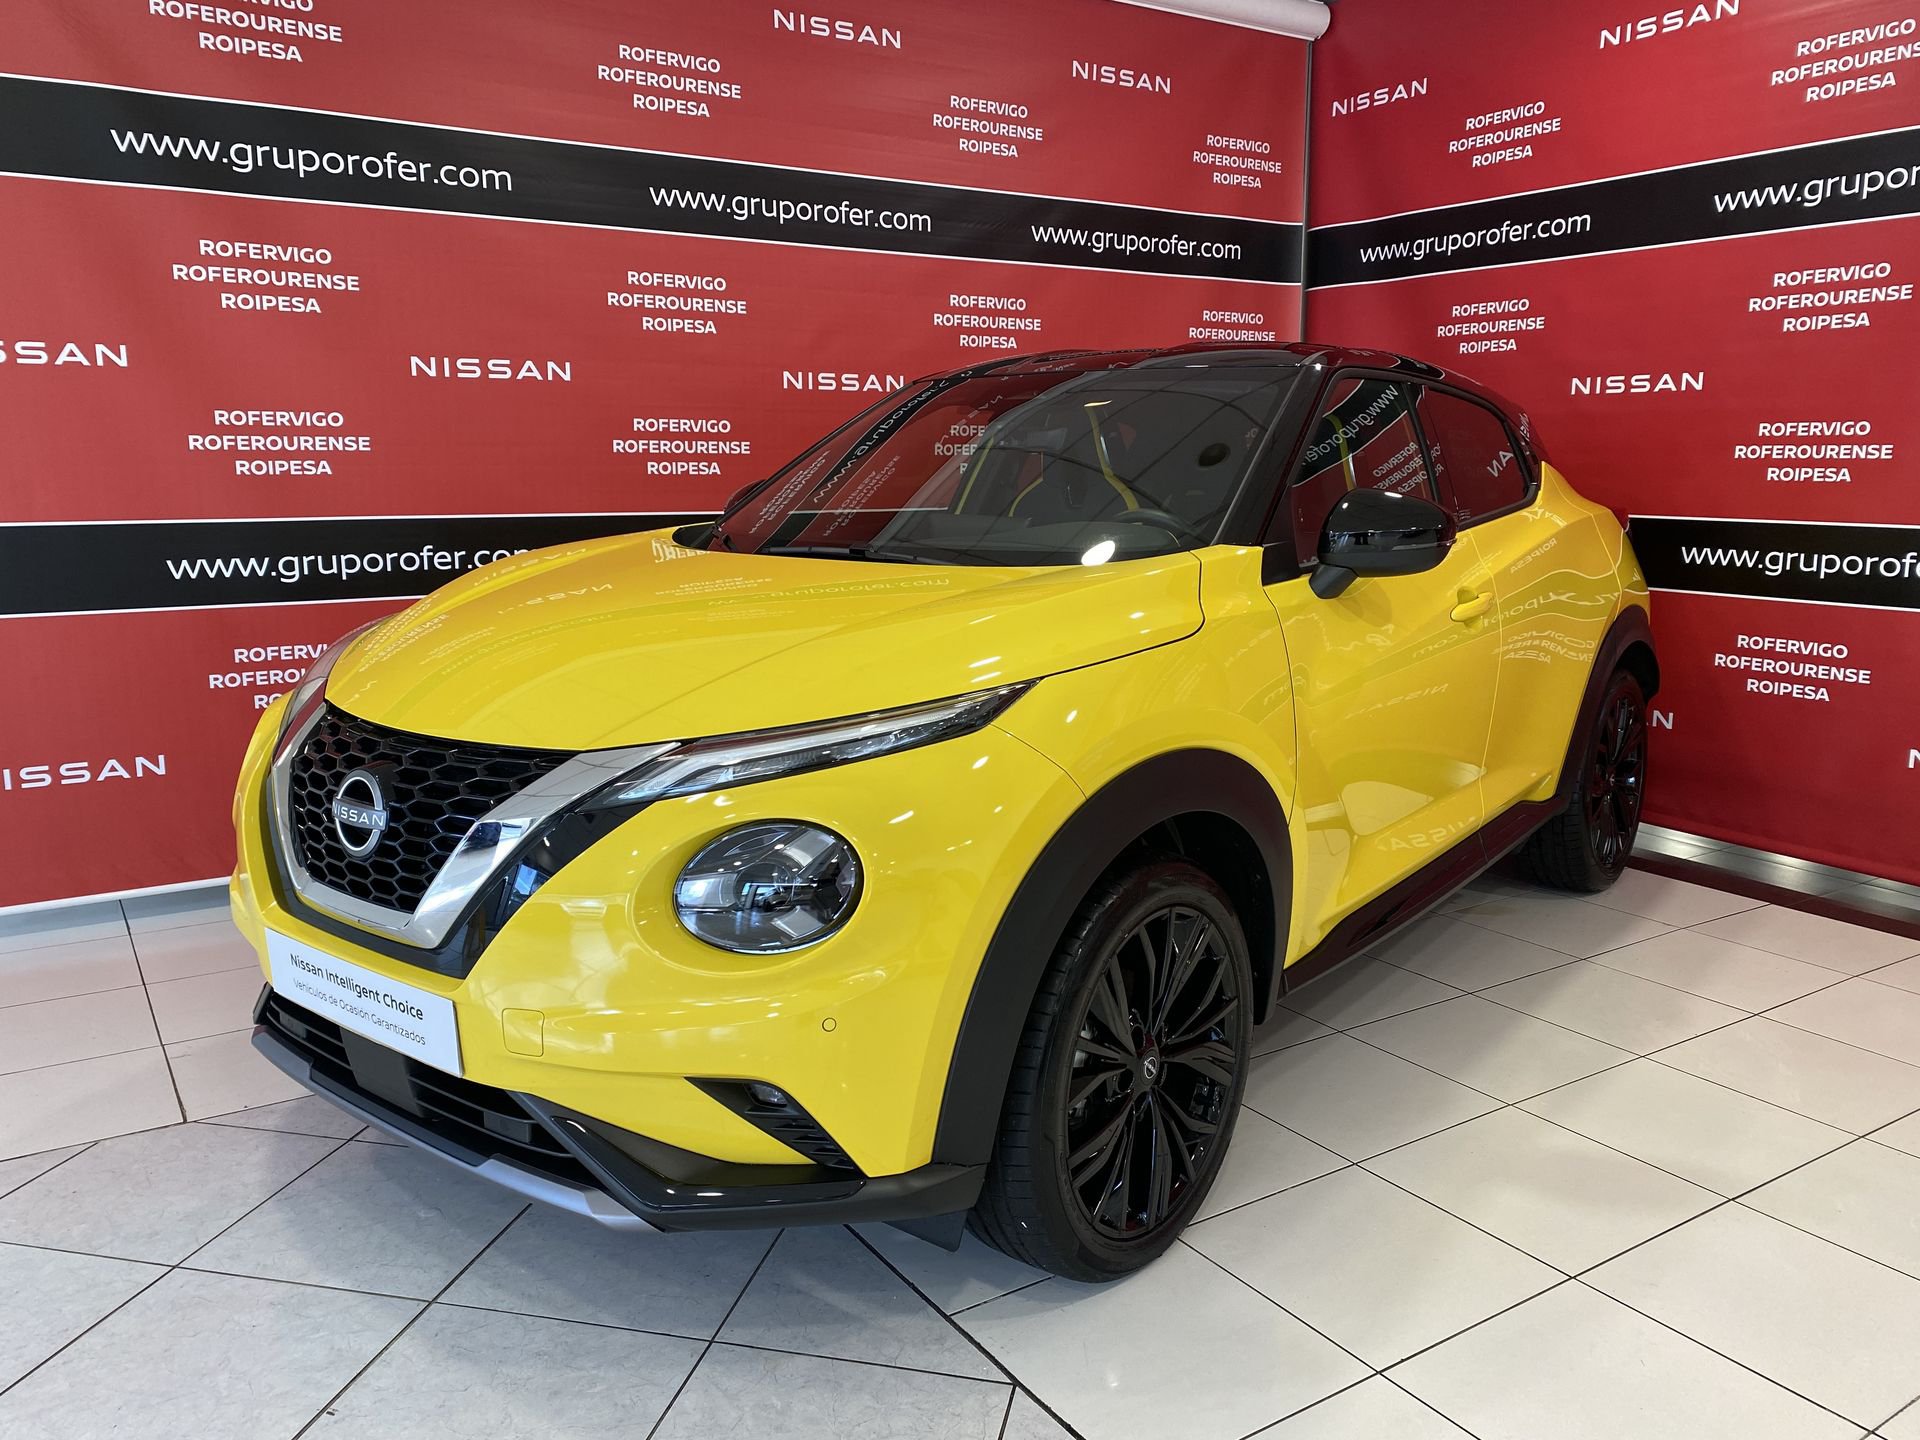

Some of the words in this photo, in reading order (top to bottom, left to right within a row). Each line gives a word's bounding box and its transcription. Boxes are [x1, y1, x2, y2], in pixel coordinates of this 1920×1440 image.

[149, 0, 342, 42] ROFEROURENSE
[774, 10, 900, 48] NISSAN
[1600, 0, 1739, 48] NISSAN
[199, 32, 302, 62] ROIPESA
[1797, 19, 1916, 56] ROFERVIGO
[620, 45, 720, 72] ROFERVIGO
[598, 65, 741, 98] ROFEROURENSE
[1073, 61, 1170, 93] NISSAN
[1807, 72, 1895, 102] ROIPESA
[634, 94, 709, 117] ROIPESA
[951, 96, 1027, 118] ROFERVIGO
[1333, 78, 1427, 116] NISSAN
[934, 114, 1042, 140] ROFEROURENSE
[1466, 102, 1544, 130] ROFERVIGO
[1207, 135, 1269, 153] ROFERVIGO
[1450, 118, 1561, 152] ROFEROURENSE
[960, 139, 1017, 157] ROIPESA
[1473, 145, 1532, 167] ROIPESA
[110, 130, 511, 190] www.gruporofer.com
[1194, 151, 1281, 173] ROFEROURENSE
[1214, 173, 1261, 188] ROIPESA
[650, 187, 930, 232] www.gruporofer.com
[1032, 226, 1240, 259] www.gruporofer.com
[1361, 215, 1590, 262] www.gruporofer.com
[200, 240, 331, 264] ROFERVIGO
[173, 264, 359, 290] ROFEROURENSE
[628, 271, 726, 290] ROFERVIGO
[1774, 263, 1890, 287] ROFERVIGO
[221, 293, 321, 313] ROIPESA
[608, 292, 746, 313] ROFEROURENSE
[950, 295, 1026, 310] ROFERVIGO
[1453, 299, 1529, 317] ROFERVIGO
[1749, 285, 1913, 311] ROFEROURENSE
[643, 317, 716, 333] ROIPESA
[934, 314, 1041, 330] ROFEROURENSE
[1203, 311, 1263, 324] ROFERVIGO
[1438, 317, 1544, 336] ROFEROURENSE
[1783, 313, 1869, 331] ROIPESA
[960, 335, 1017, 348] ROIPESA
[1190, 328, 1275, 341] ROFEROURENSE
[0, 341, 127, 366] SAN
[1460, 339, 1516, 353] ROIPESA
[411, 357, 570, 381] NISSAN
[783, 371, 903, 392] NISSAN
[1571, 372, 1703, 394] NISSAN
[215, 411, 343, 426] ROFERVIGO
[634, 419, 730, 432] ROFERVIGO
[1759, 421, 1870, 436] ROFERVIGO
[189, 435, 370, 450] ROFEROURENSE
[613, 440, 750, 453] ROFEROURENSE
[1735, 445, 1893, 458] ROFEROURENSE
[236, 461, 332, 475] ROIPESA
[648, 462, 720, 474] ROIPESA
[1767, 468, 1850, 481] ROIPESA
[1682, 547, 1920, 578] www.gruporof
[1738, 635, 1848, 658] ROFERVIGO
[1715, 654, 1870, 683] ROFEROURENSE
[1747, 679, 1829, 701] ROIPESA
[3, 755, 165, 790] ISSAN
[333, 801, 384, 826] NISSAN
[290, 954, 323, 978] Nissan
[325, 968, 381, 1003] Intelligent
[383, 994, 424, 1020] Choice
[329, 995, 338, 1007] de
